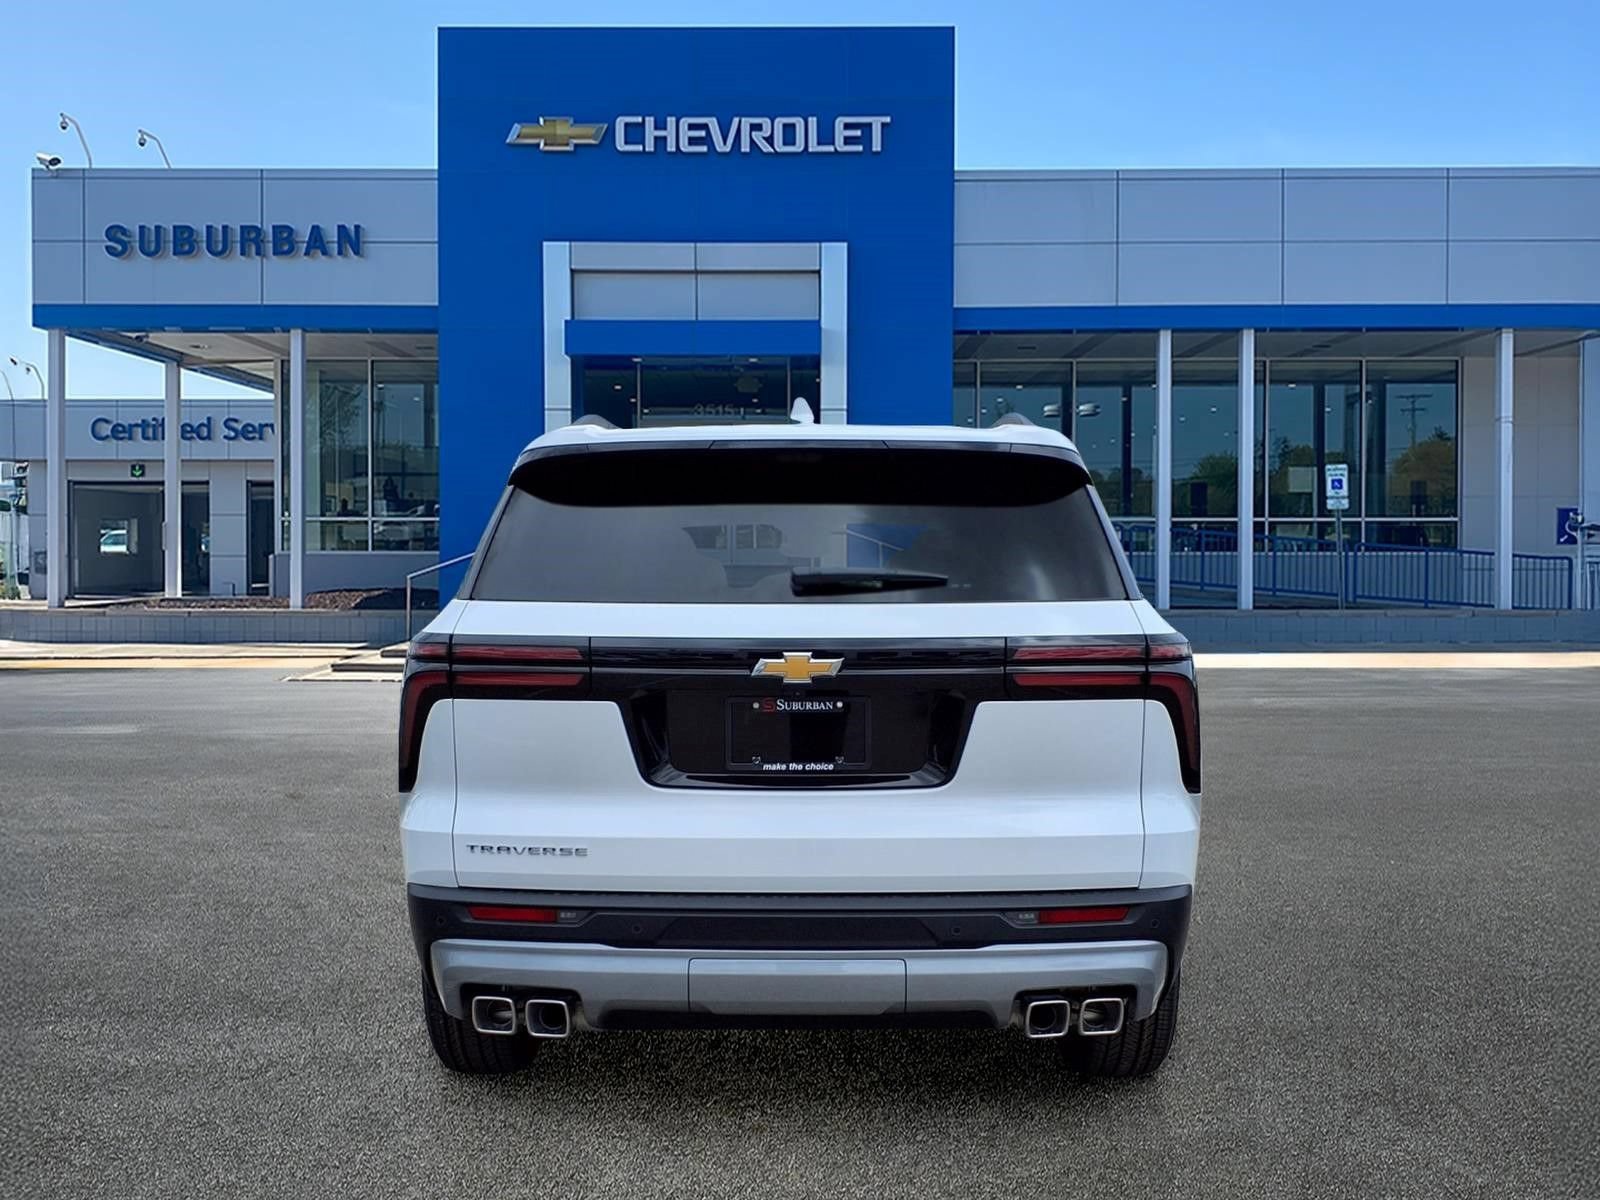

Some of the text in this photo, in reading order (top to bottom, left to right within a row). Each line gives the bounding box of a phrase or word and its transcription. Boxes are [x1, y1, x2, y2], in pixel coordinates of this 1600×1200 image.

[615, 115, 891, 153] CHEVROLET
[104, 223, 363, 258] SUBURBAN
[776, 698, 834, 711] SUBURBAN
[763, 763, 834, 771] make the choice
[466, 844, 588, 857] TRAVERSE
